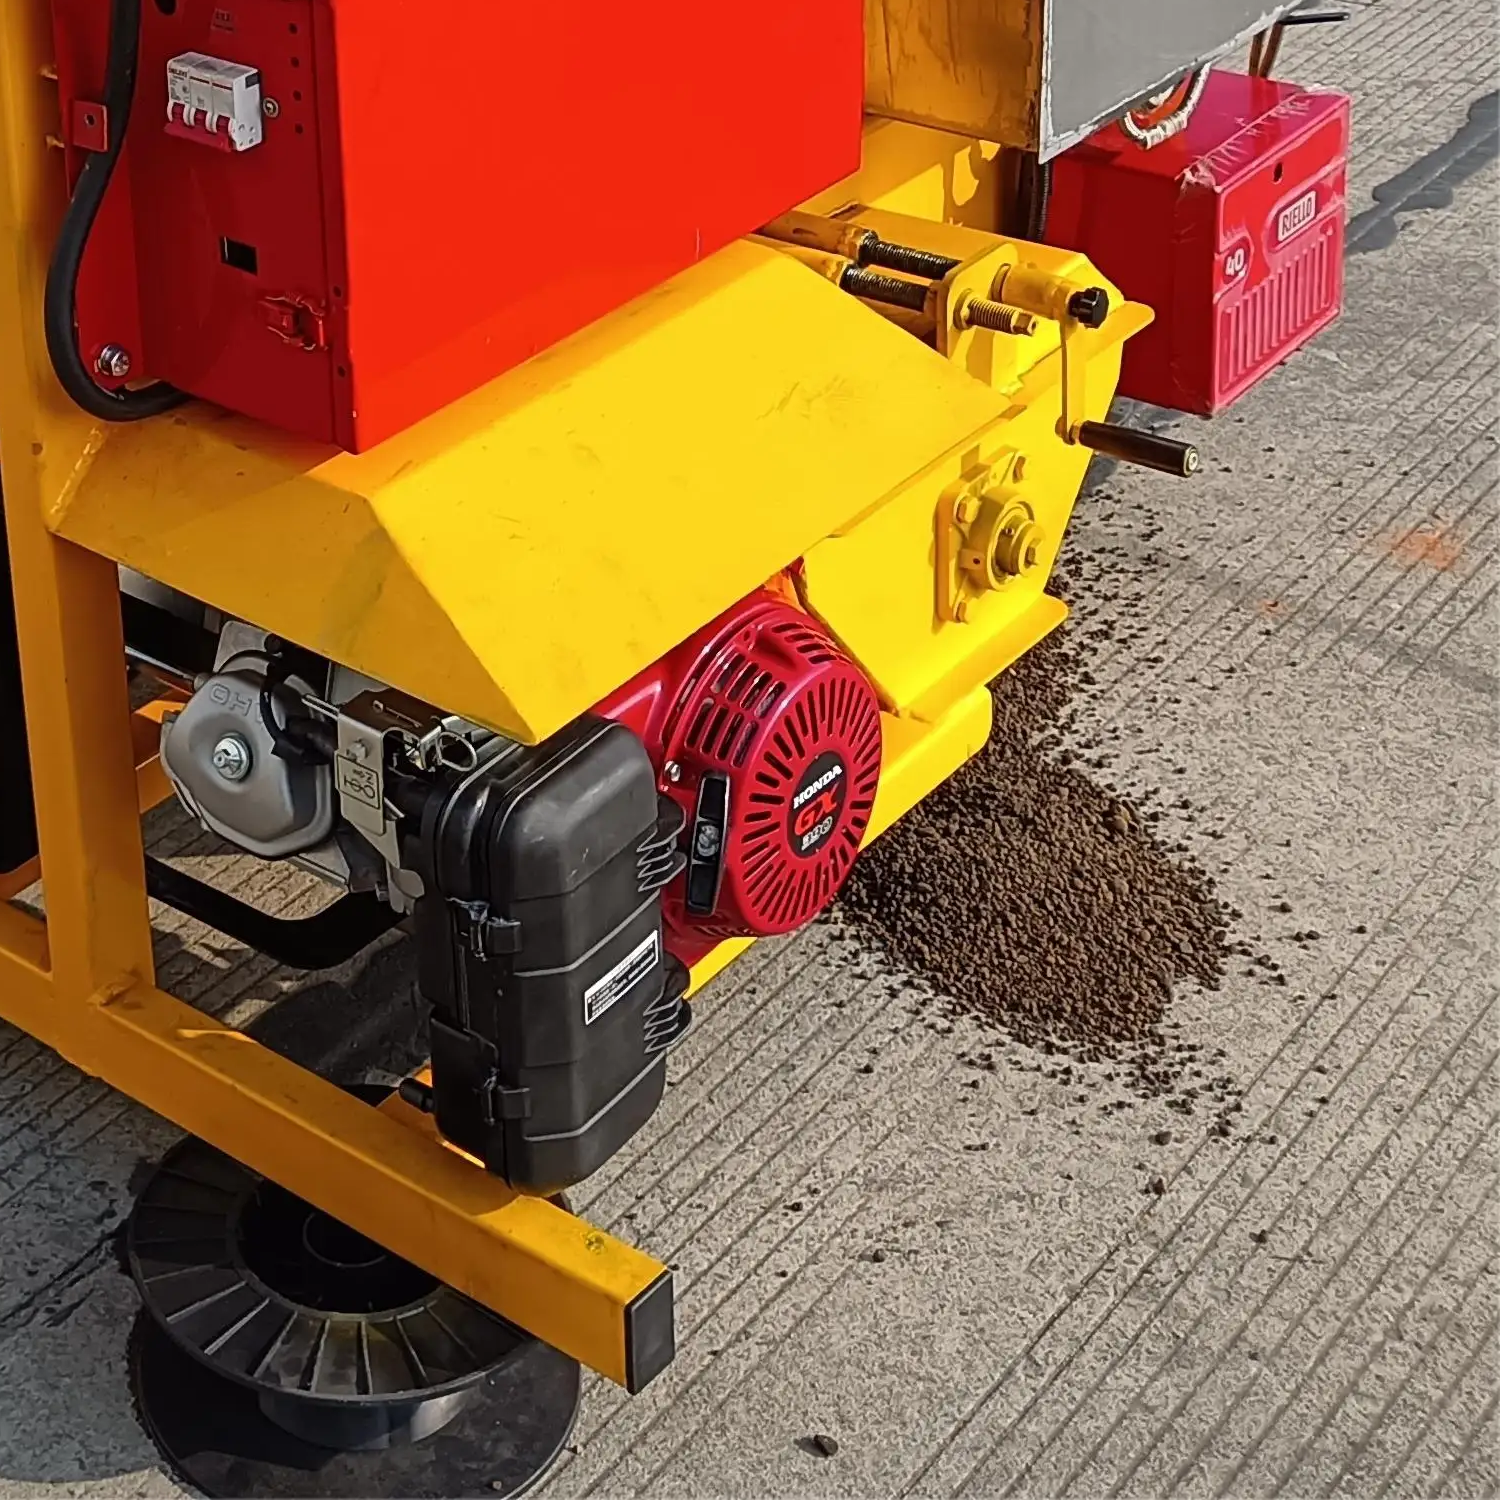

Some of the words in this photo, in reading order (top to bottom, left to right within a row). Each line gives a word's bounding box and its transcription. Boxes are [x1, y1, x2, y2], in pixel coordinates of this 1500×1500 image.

[1281, 196, 1312, 236] RIELLO
[1225, 248, 1245, 276] 40
[208, 682, 263, 724] OH
[793, 765, 842, 809] HONDA
[794, 781, 840, 835] GX
